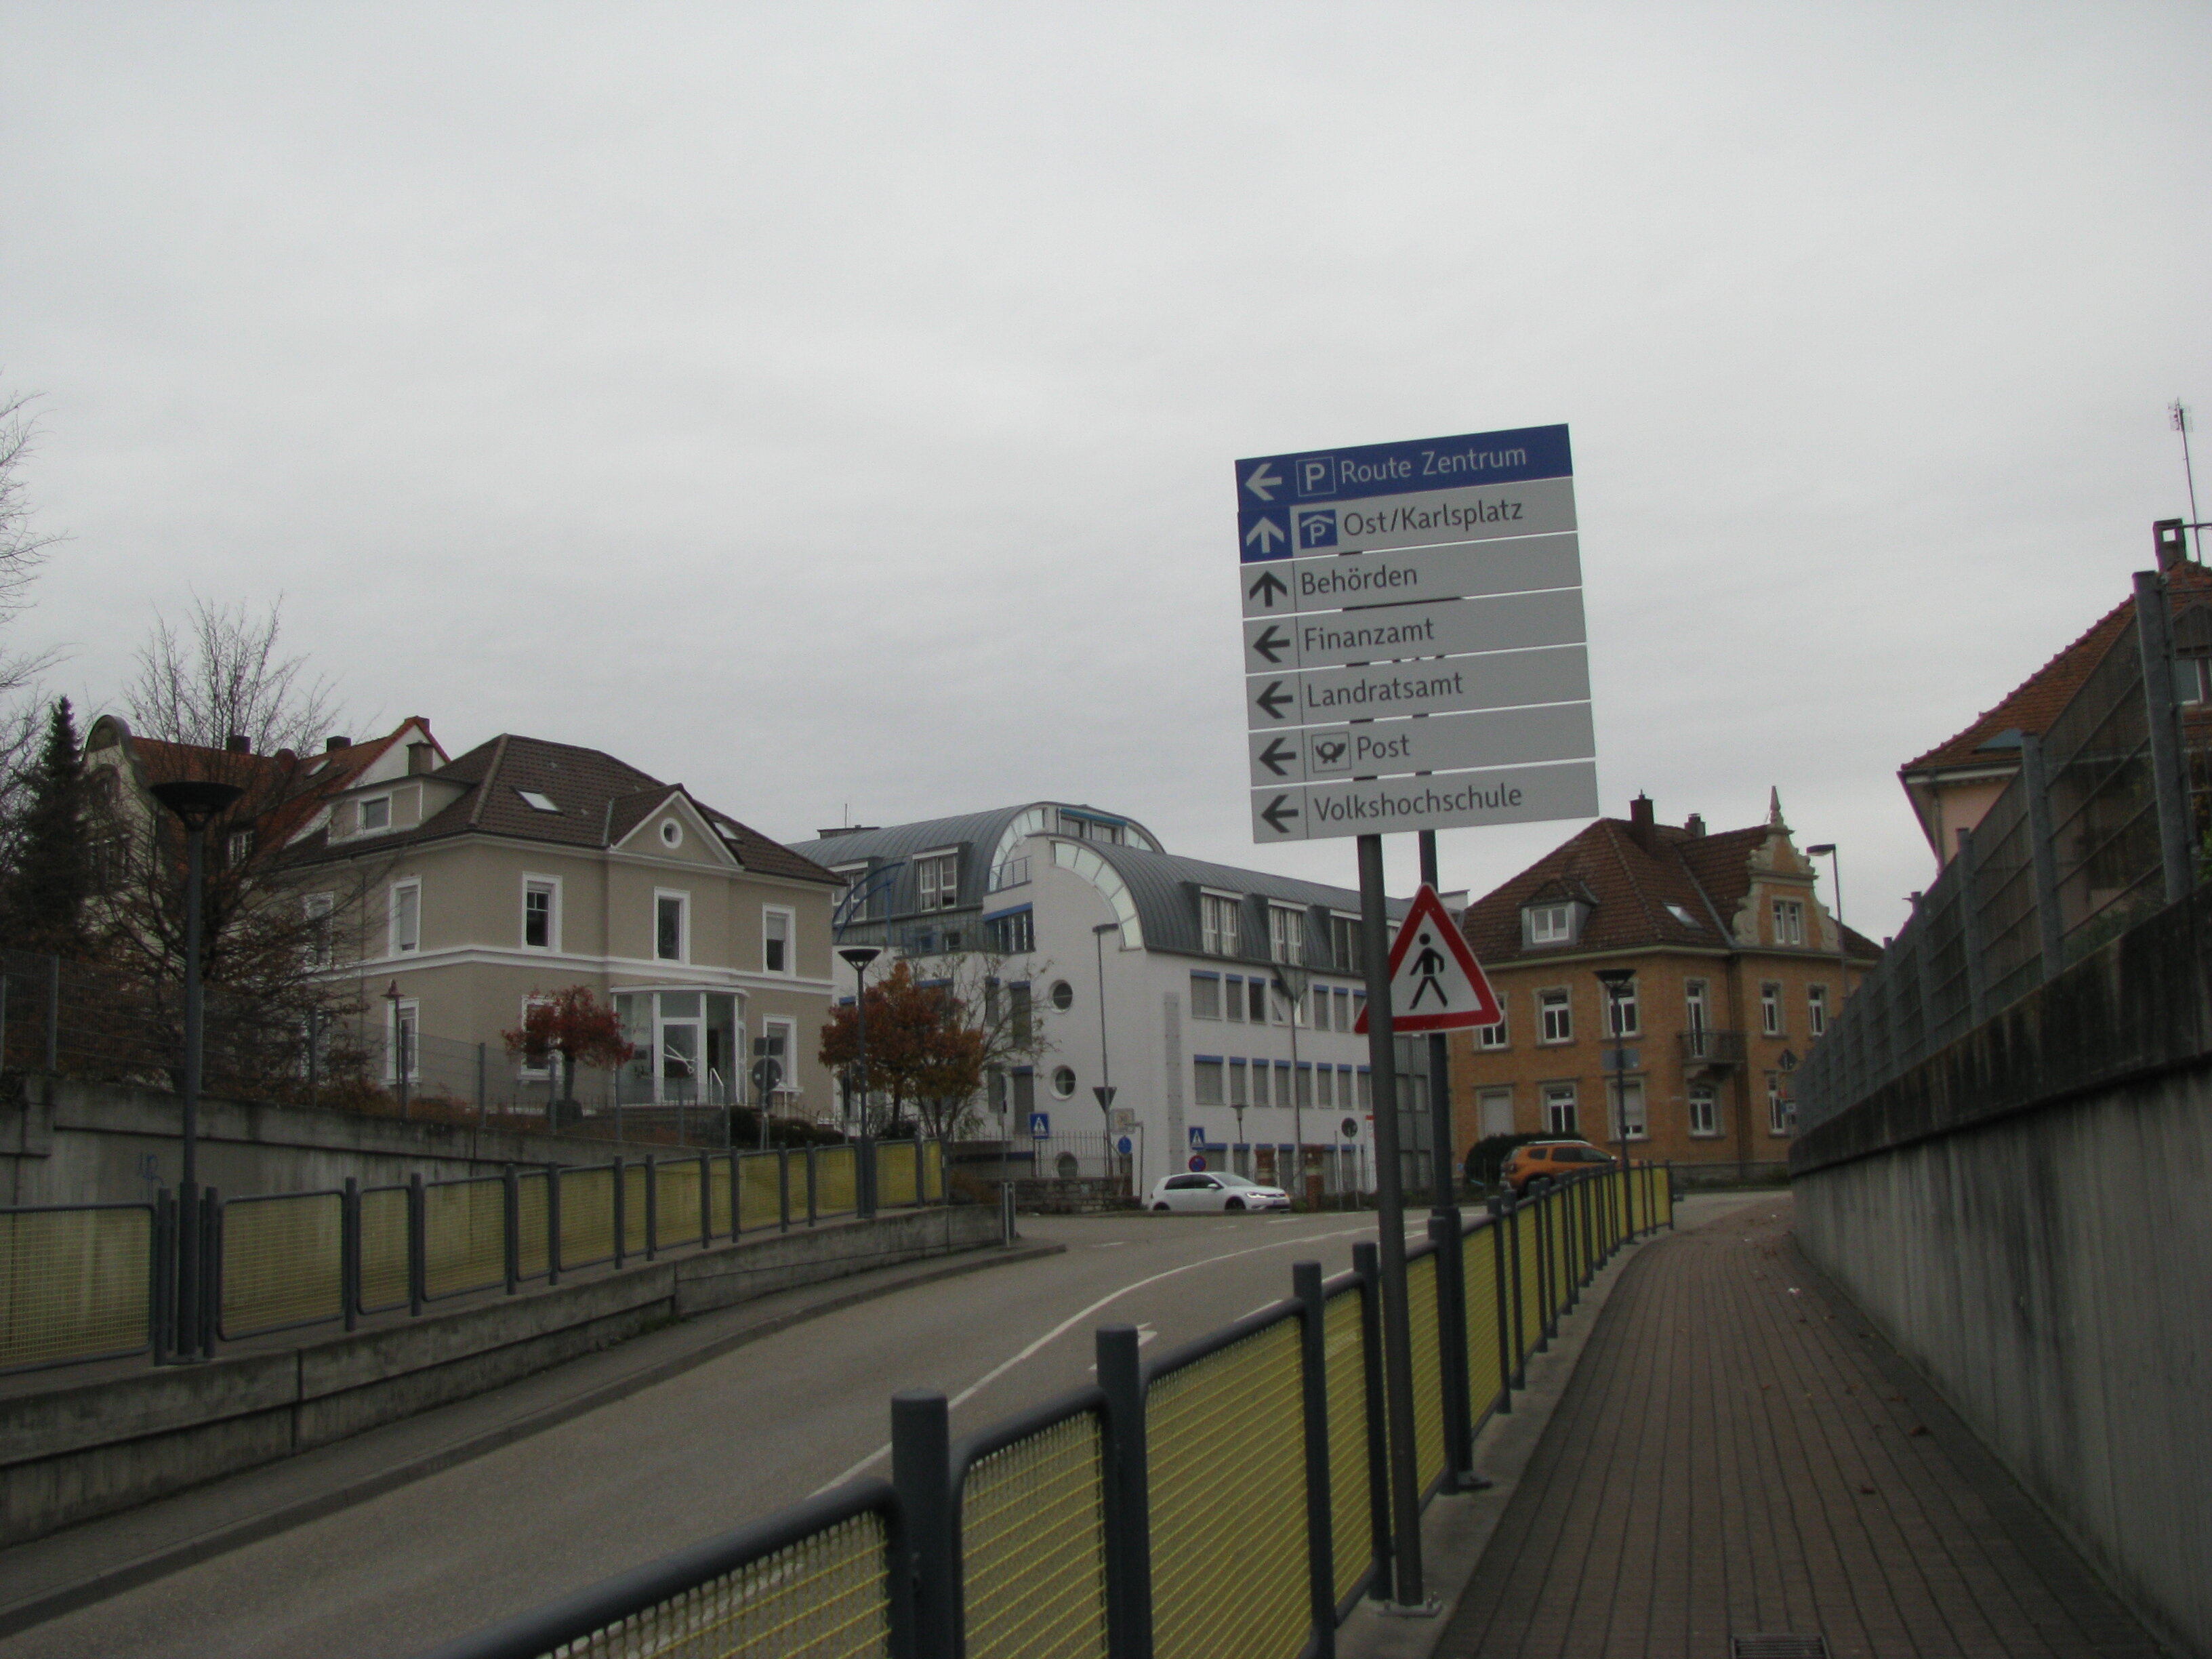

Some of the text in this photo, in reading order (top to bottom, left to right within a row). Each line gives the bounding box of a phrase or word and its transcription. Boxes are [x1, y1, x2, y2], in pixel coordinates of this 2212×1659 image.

[1306, 448, 1526, 491] P Route Zentrum
[1343, 499, 1523, 535] Ost/Karlsplatz
[1302, 565, 1417, 596] Behörden
[1305, 617, 1434, 652] Finanzamt
[1308, 672, 1463, 707] Landratsamt
[1357, 734, 1410, 760] Post
[1315, 783, 1522, 821] Volkshochschule
